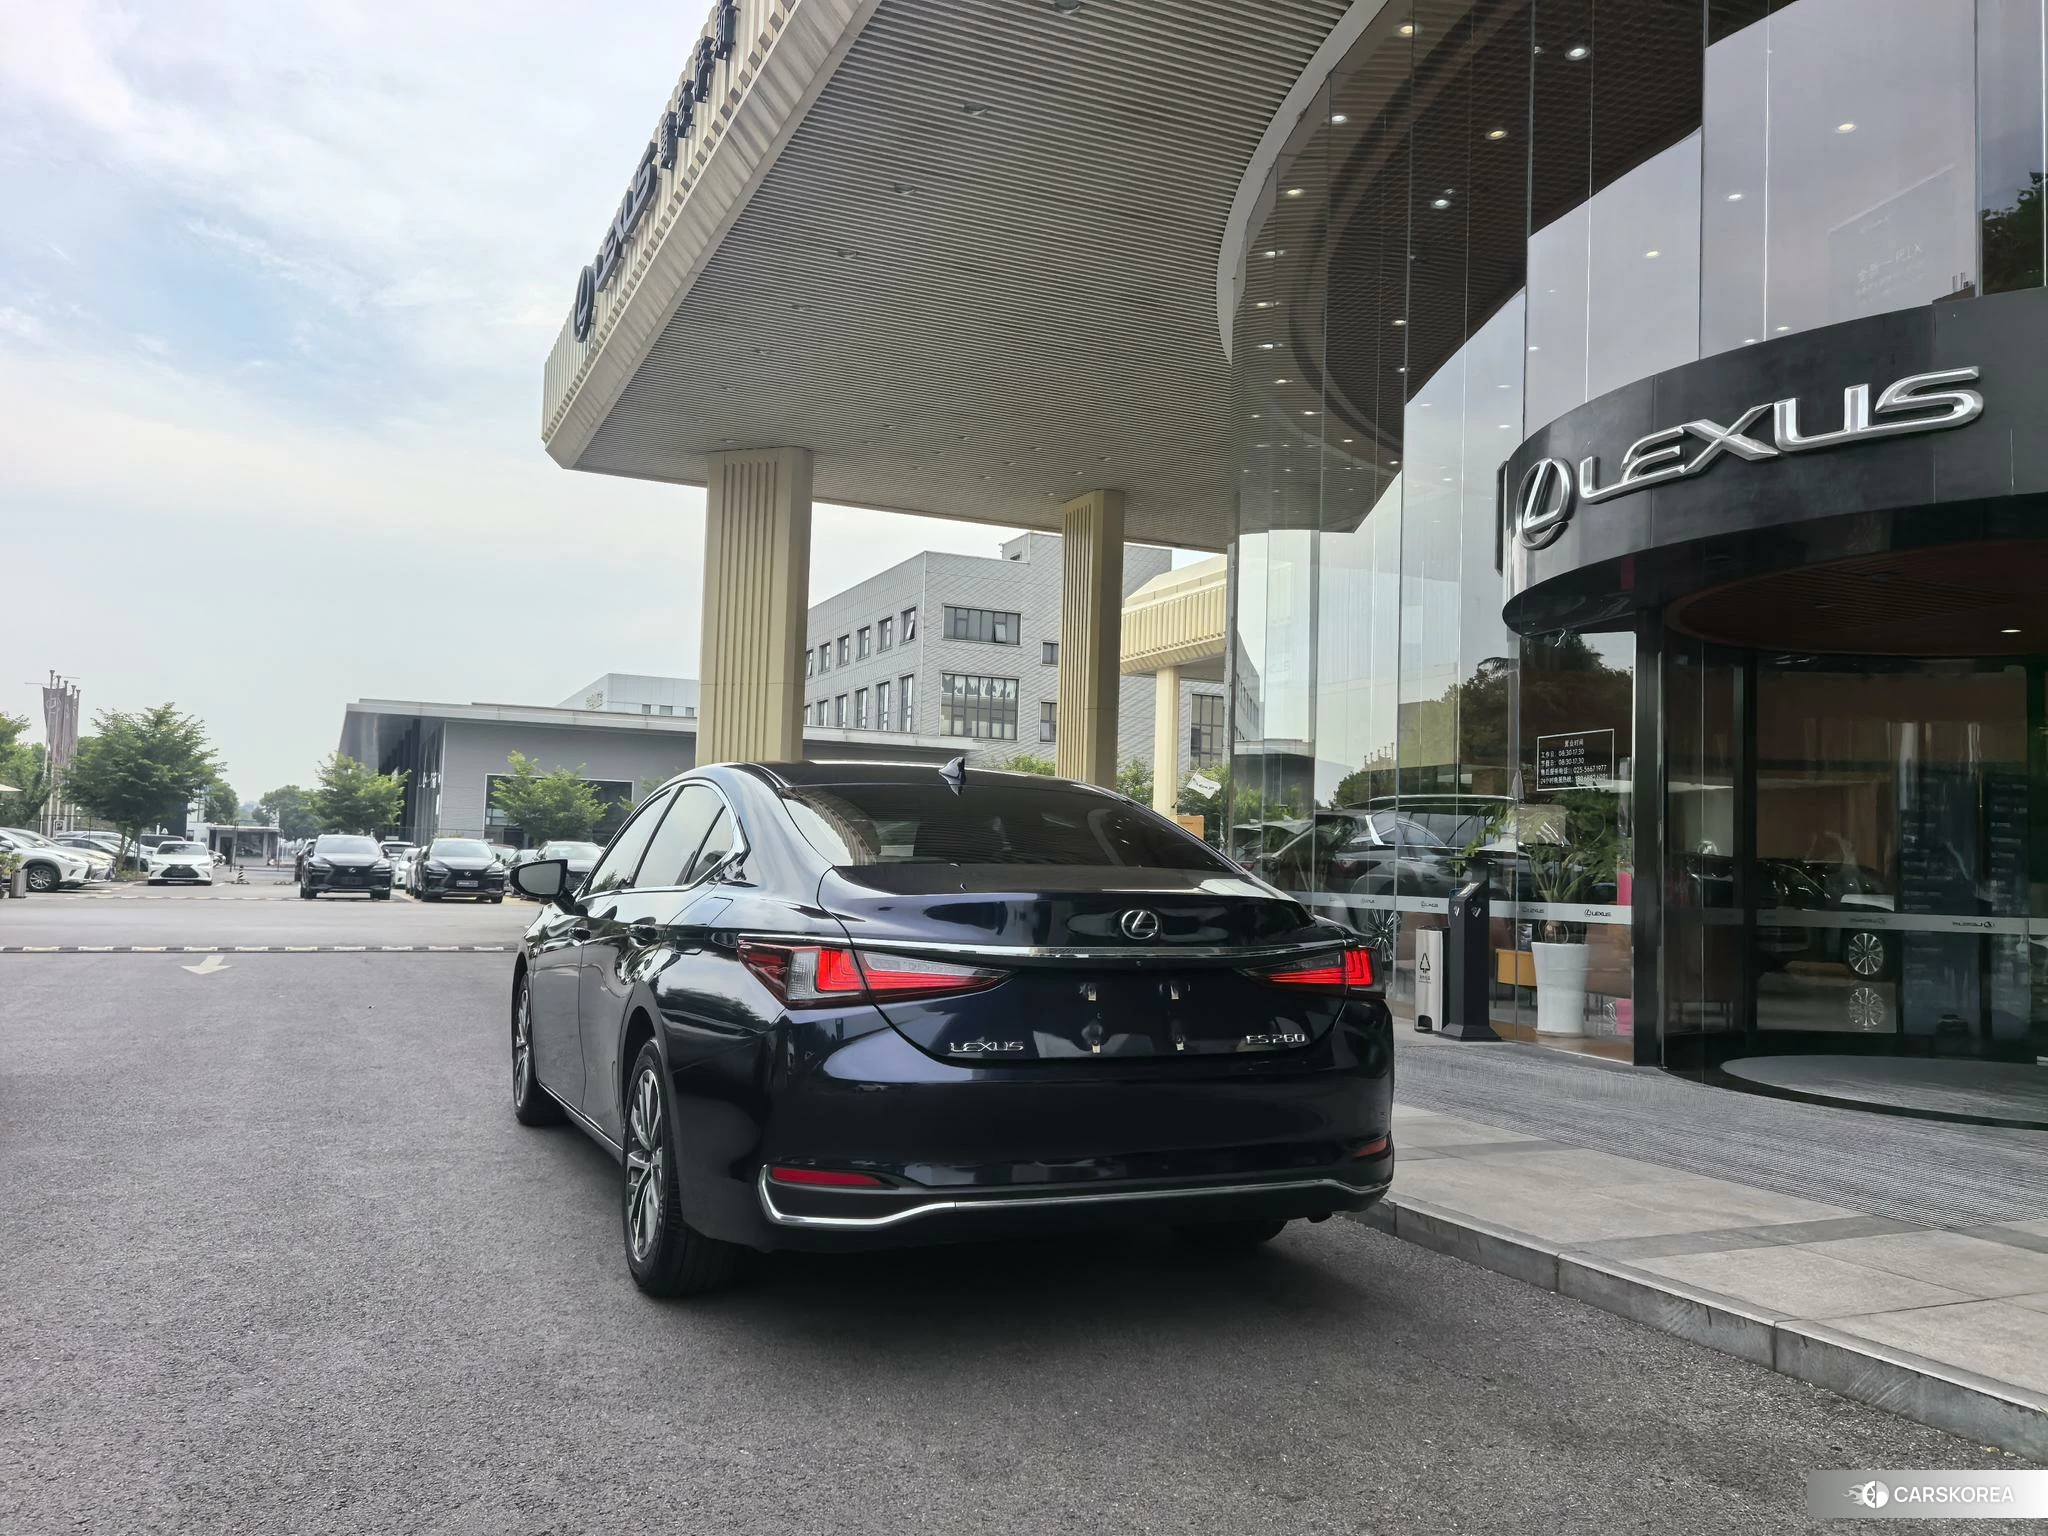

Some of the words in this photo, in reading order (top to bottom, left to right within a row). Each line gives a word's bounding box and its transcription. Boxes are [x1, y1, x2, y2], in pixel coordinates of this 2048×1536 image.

[595, 142, 658, 292] LEXUS
[1579, 365, 1984, 504] LEXUS
[950, 1041, 1024, 1053] LEXUS
[1272, 1033, 1305, 1044] 260
